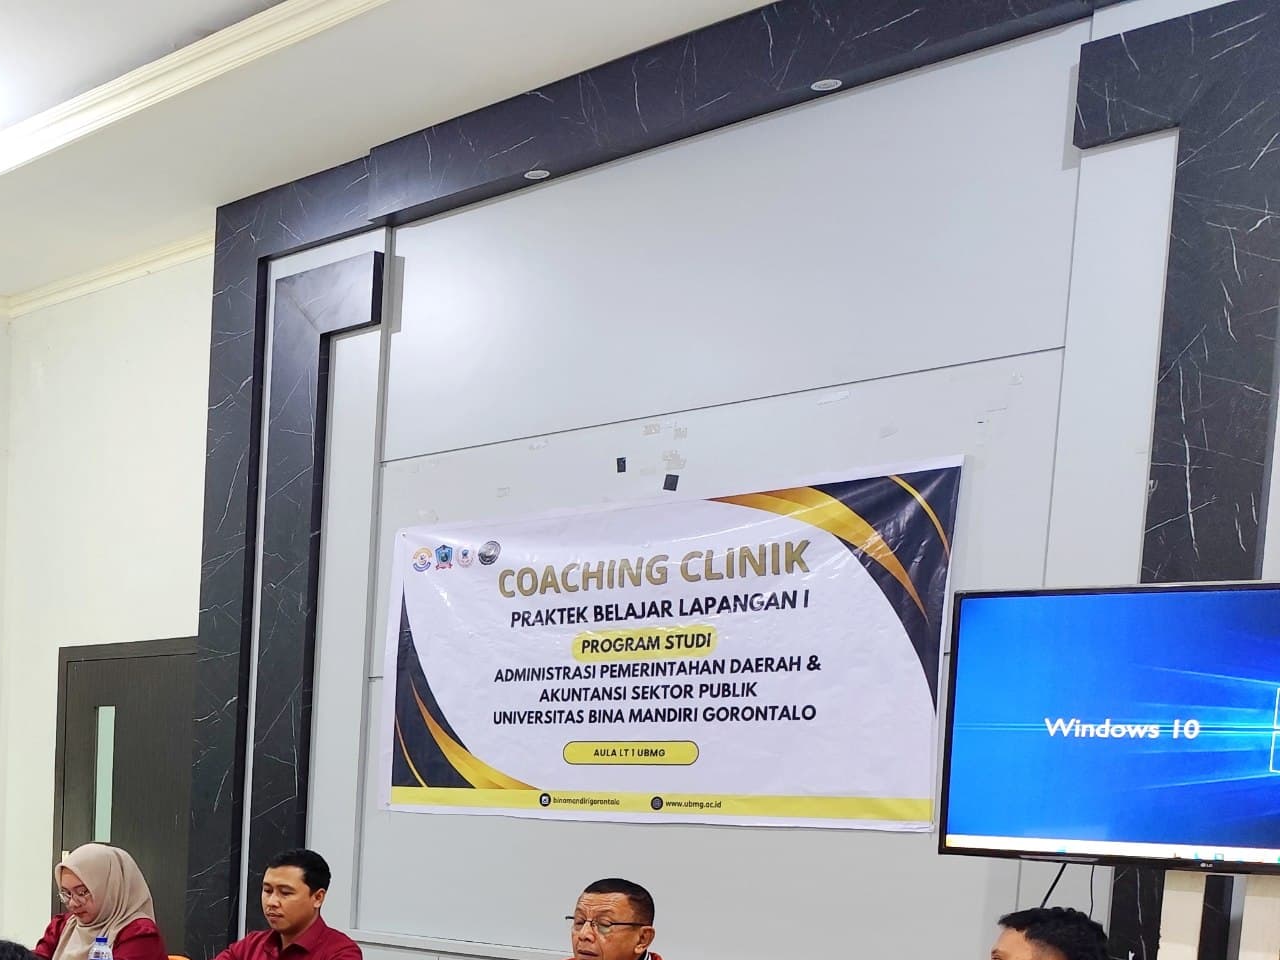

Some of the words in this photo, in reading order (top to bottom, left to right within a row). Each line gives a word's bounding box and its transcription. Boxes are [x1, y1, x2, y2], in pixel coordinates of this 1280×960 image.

[498, 554, 669, 598] COACHING
[510, 605, 589, 628] PRAKTEK
[593, 600, 674, 622] BELAJAR
[679, 590, 798, 617] LAPANGAN
[581, 635, 660, 654] PROGRAM
[664, 632, 712, 650] STUDI
[494, 665, 596, 683] ADMINISTRASI
[599, 659, 726, 679] PEMERINTAHAN
[729, 655, 802, 674] DAERAH
[806, 654, 822, 672] &
[539, 686, 627, 702] AKUNTANSI
[631, 684, 694, 700] SEKTOR
[698, 681, 758, 699] PUBLIK
[493, 709, 584, 725] UNIVERSITAS
[588, 708, 625, 724] BINA
[628, 707, 698, 723] MANDIRI
[702, 704, 817, 722] GORONTALO
[1044, 718, 1160, 739] Windows
[1171, 719, 1201, 740] 10
[593, 748, 617, 757] AULA
[619, 748, 629, 757] LT
[637, 748, 666, 757] UBMG
[665, 800, 722, 810] www.ubmg.ac.id
